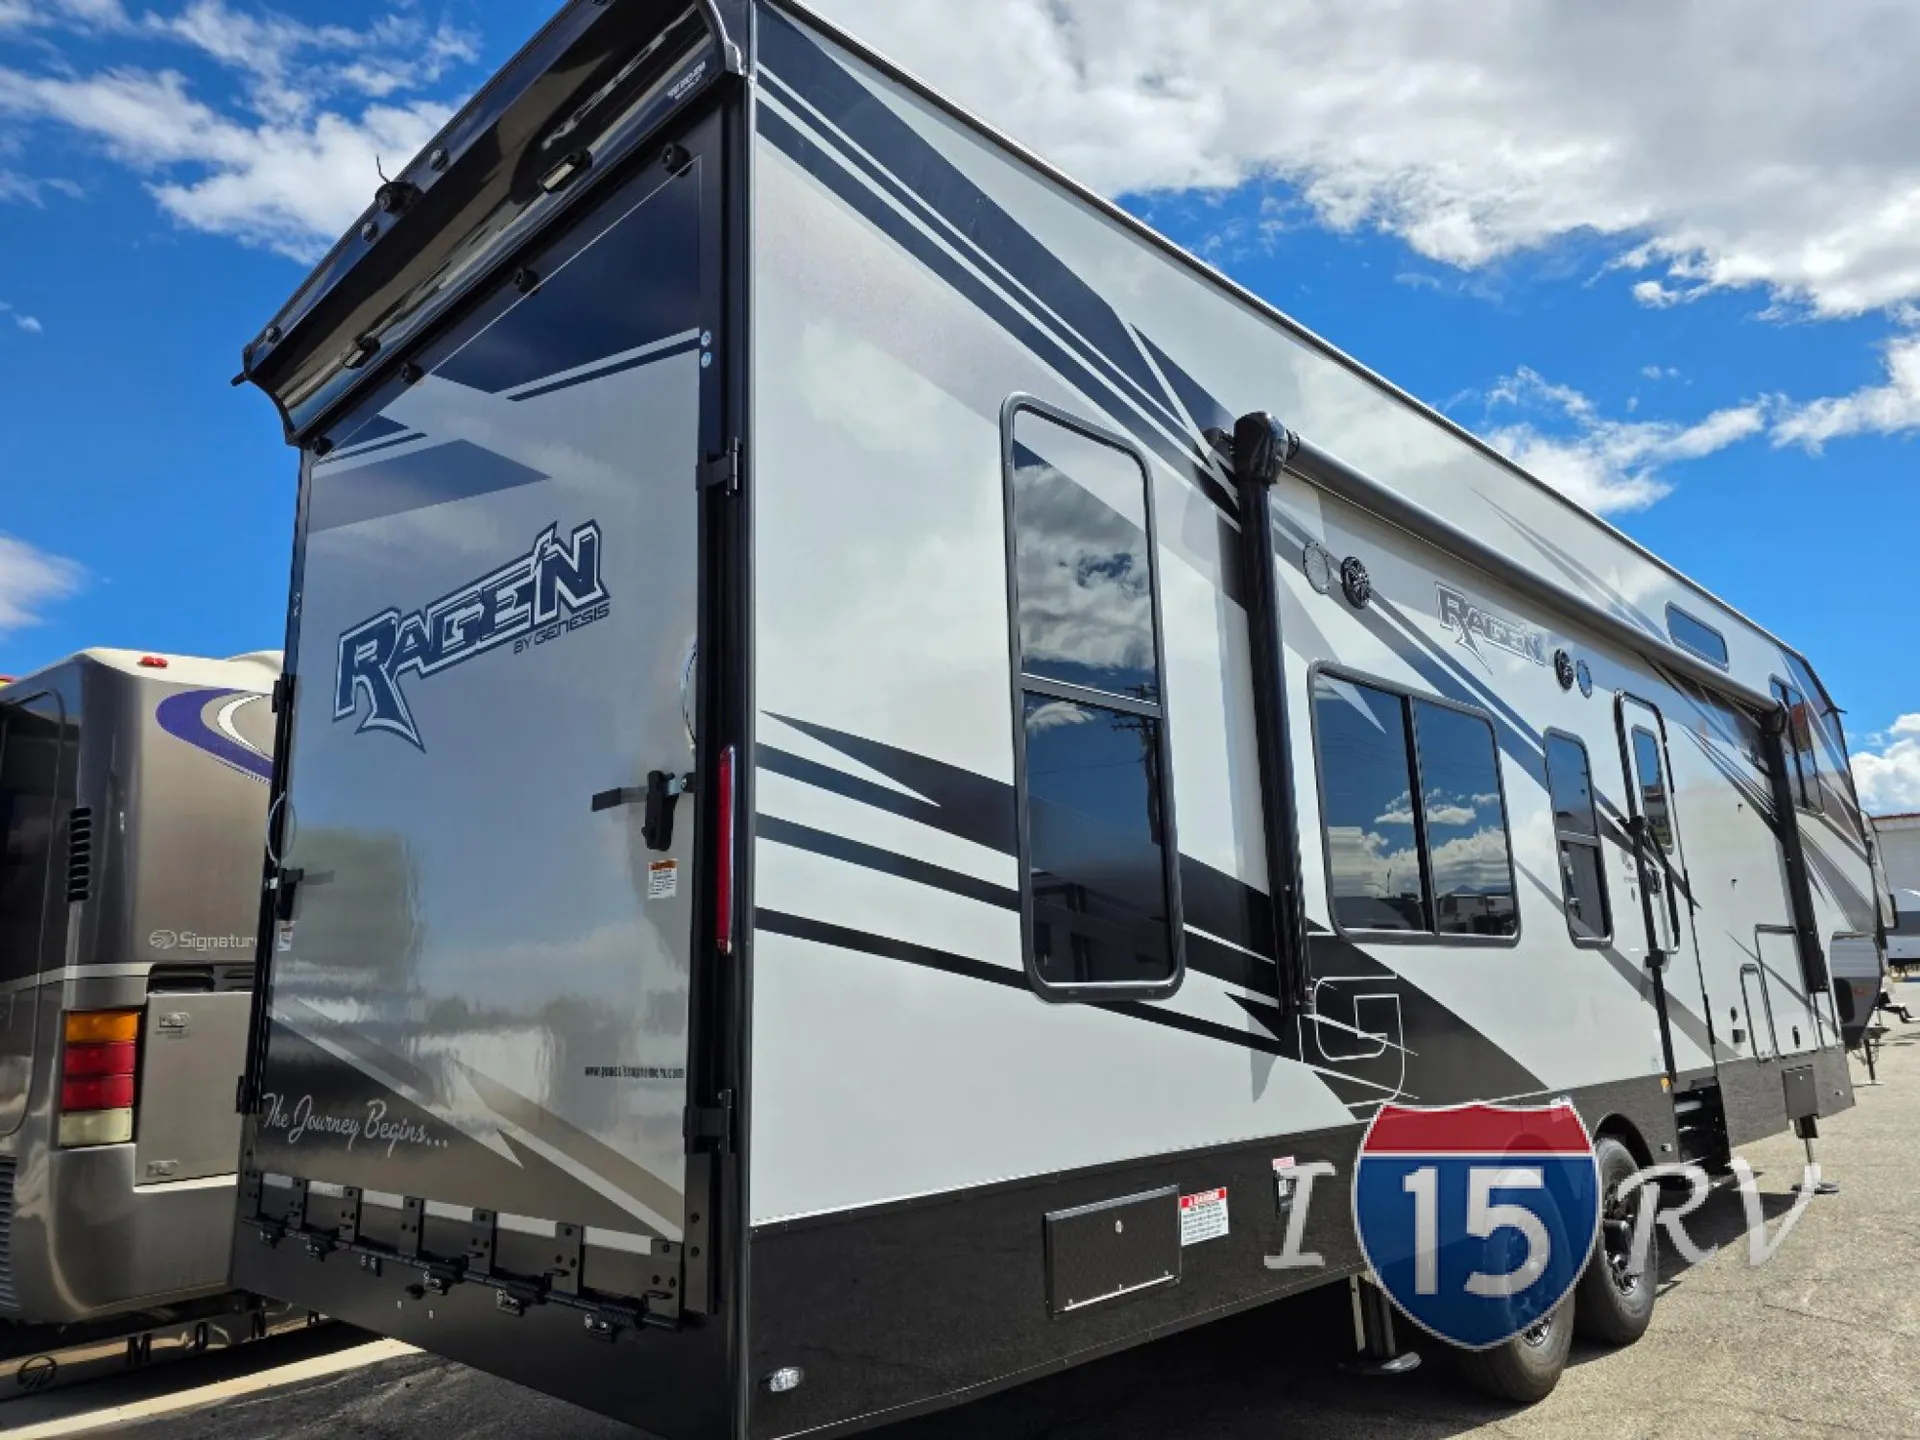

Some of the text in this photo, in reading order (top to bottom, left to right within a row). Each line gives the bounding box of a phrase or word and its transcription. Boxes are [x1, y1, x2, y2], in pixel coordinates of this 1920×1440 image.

[514, 600, 611, 654] BY GENESIS
[179, 931, 259, 951] Signatur
[262, 1092, 289, 1128] The
[288, 1094, 361, 1151] Journey
